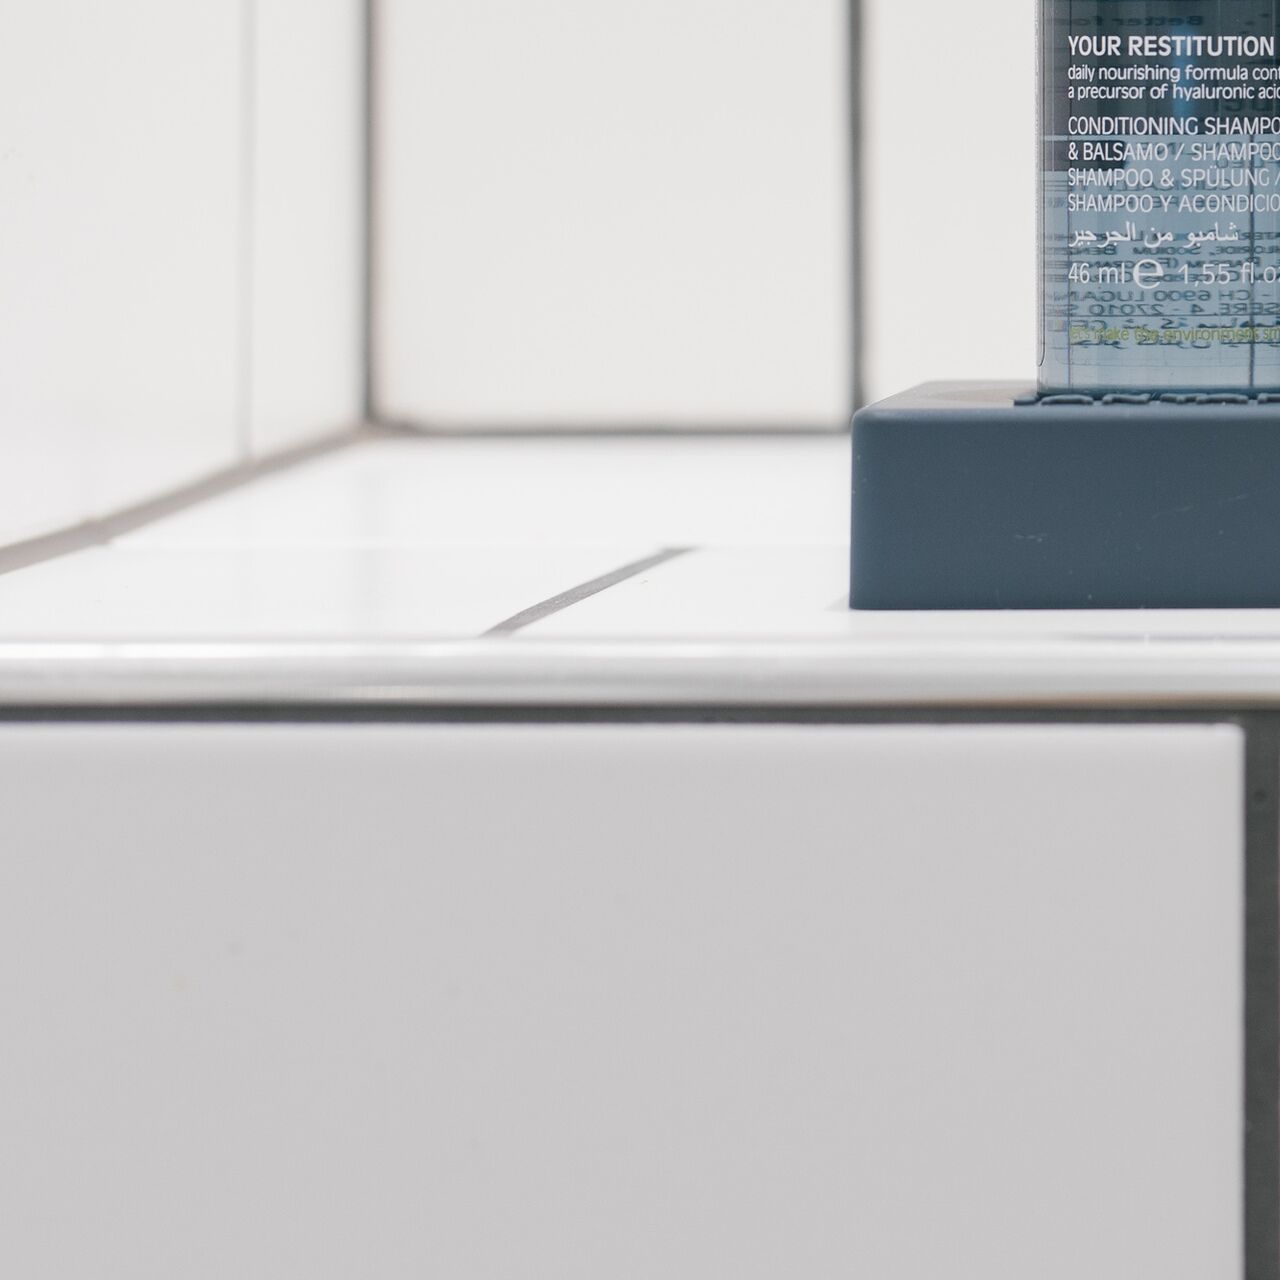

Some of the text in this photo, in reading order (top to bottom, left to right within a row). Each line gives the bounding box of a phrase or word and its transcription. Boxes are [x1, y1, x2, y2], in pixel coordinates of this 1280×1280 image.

[1068, 35, 1275, 56] YOUR RESTITUTION
[1068, 66, 1095, 83] daily
[1099, 65, 1180, 83] nourishing
[1185, 65, 1248, 81] formula
[1078, 87, 1144, 101] precursor
[1173, 83, 1254, 101] hyaluronic
[1068, 117, 1198, 136] CONDITIONING
[1083, 143, 1168, 161] BALSAMO
[1068, 165, 1270, 187] SHAMPOO SPÜLUNG
[1068, 194, 1153, 212] SHAMPOO
[1144, 227, 1174, 248] من
[1068, 263, 1090, 284] 46
[1098, 263, 1125, 284] ml
[1178, 263, 1231, 288] 1,55
